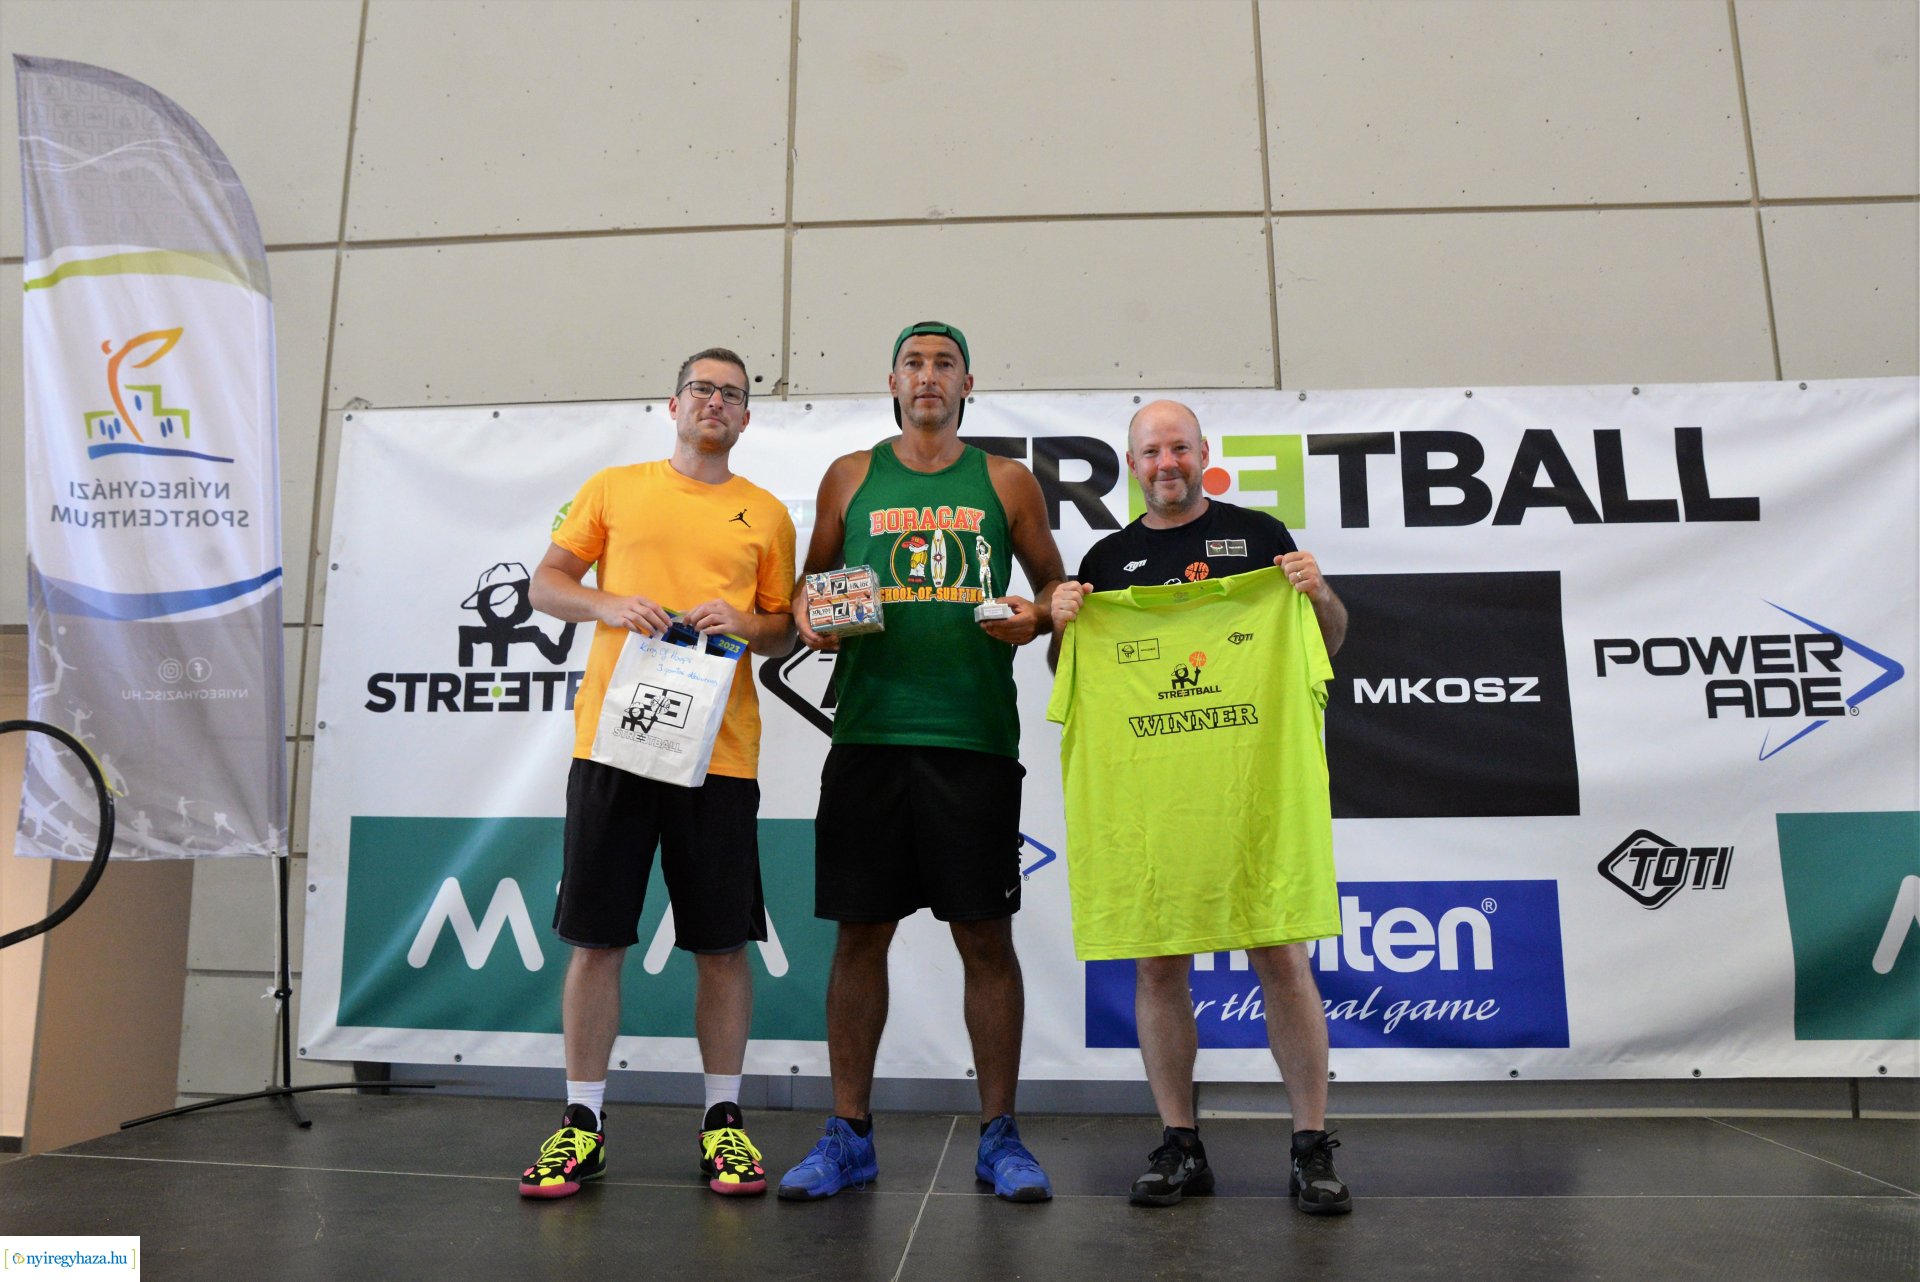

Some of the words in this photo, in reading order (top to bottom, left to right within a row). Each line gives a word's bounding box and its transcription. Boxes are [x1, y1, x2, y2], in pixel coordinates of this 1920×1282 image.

[957, 427, 1760, 531] RETBALL
[869, 505, 985, 536] BORACAY
[879, 587, 914, 602] CHOOL
[918, 587, 933, 601] OF
[718, 640, 741, 653] 2023
[1593, 632, 1844, 677] POWER
[364, 671, 586, 713] STREET
[1158, 685, 1222, 700] STREETBALL
[1353, 677, 1541, 704] MKOSZ
[1705, 677, 1845, 719] ADE
[1128, 704, 1258, 737] WINNER
[612, 727, 683, 754] STREETBALL
[1628, 846, 1735, 890] TOTI
[1221, 985, 1266, 1021] th
[1321, 985, 1378, 1021] eal
[1384, 998, 1501, 1034] game
